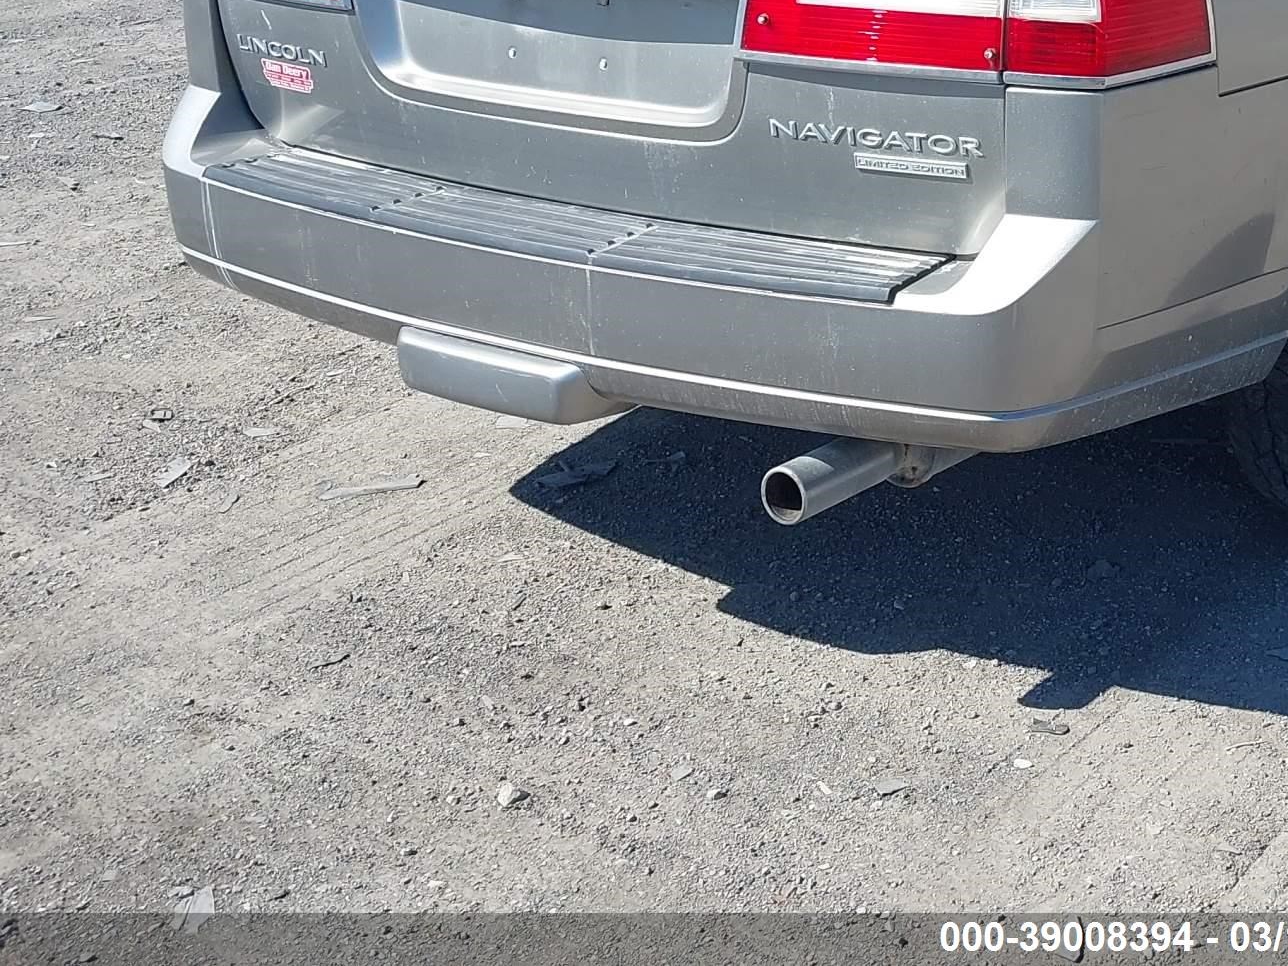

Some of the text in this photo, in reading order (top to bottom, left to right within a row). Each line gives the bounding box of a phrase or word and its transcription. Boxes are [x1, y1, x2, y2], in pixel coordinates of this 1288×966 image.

[237, 34, 328, 68] LINCOLN
[265, 61, 282, 74] Dan
[768, 118, 984, 158] NAVIGATOR
[857, 157, 966, 177] LIMITED EDITION
